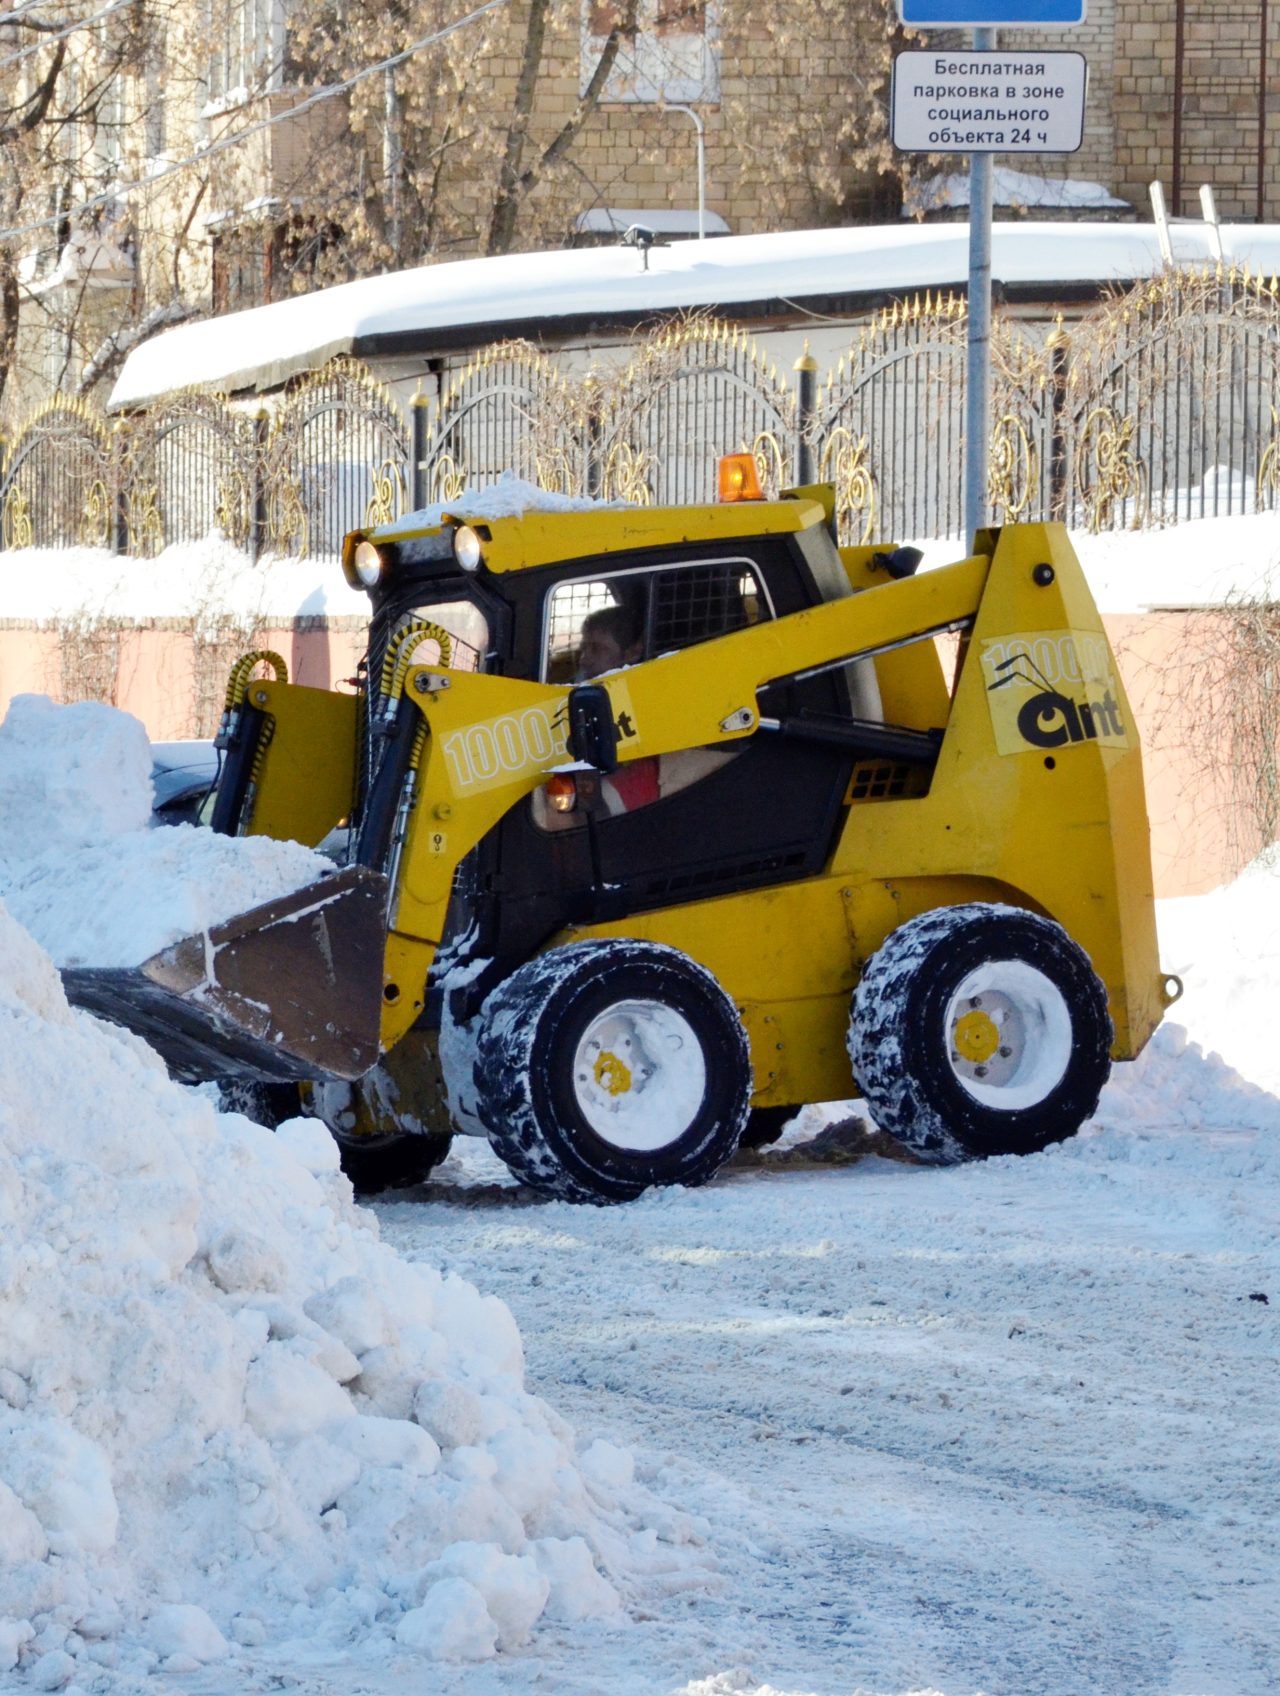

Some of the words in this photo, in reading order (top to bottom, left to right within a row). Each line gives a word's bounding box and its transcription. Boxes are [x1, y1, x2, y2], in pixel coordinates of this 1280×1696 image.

[934, 59, 1045, 76] Бесплатная
[913, 85, 999, 100] парковка
[1005, 86, 1017, 98] в
[1022, 87, 1064, 99] зоне
[927, 108, 1049, 122] социального
[929, 126, 1004, 143] объекта
[1010, 128, 1031, 144] 24
[1037, 132, 1048, 144] ч
